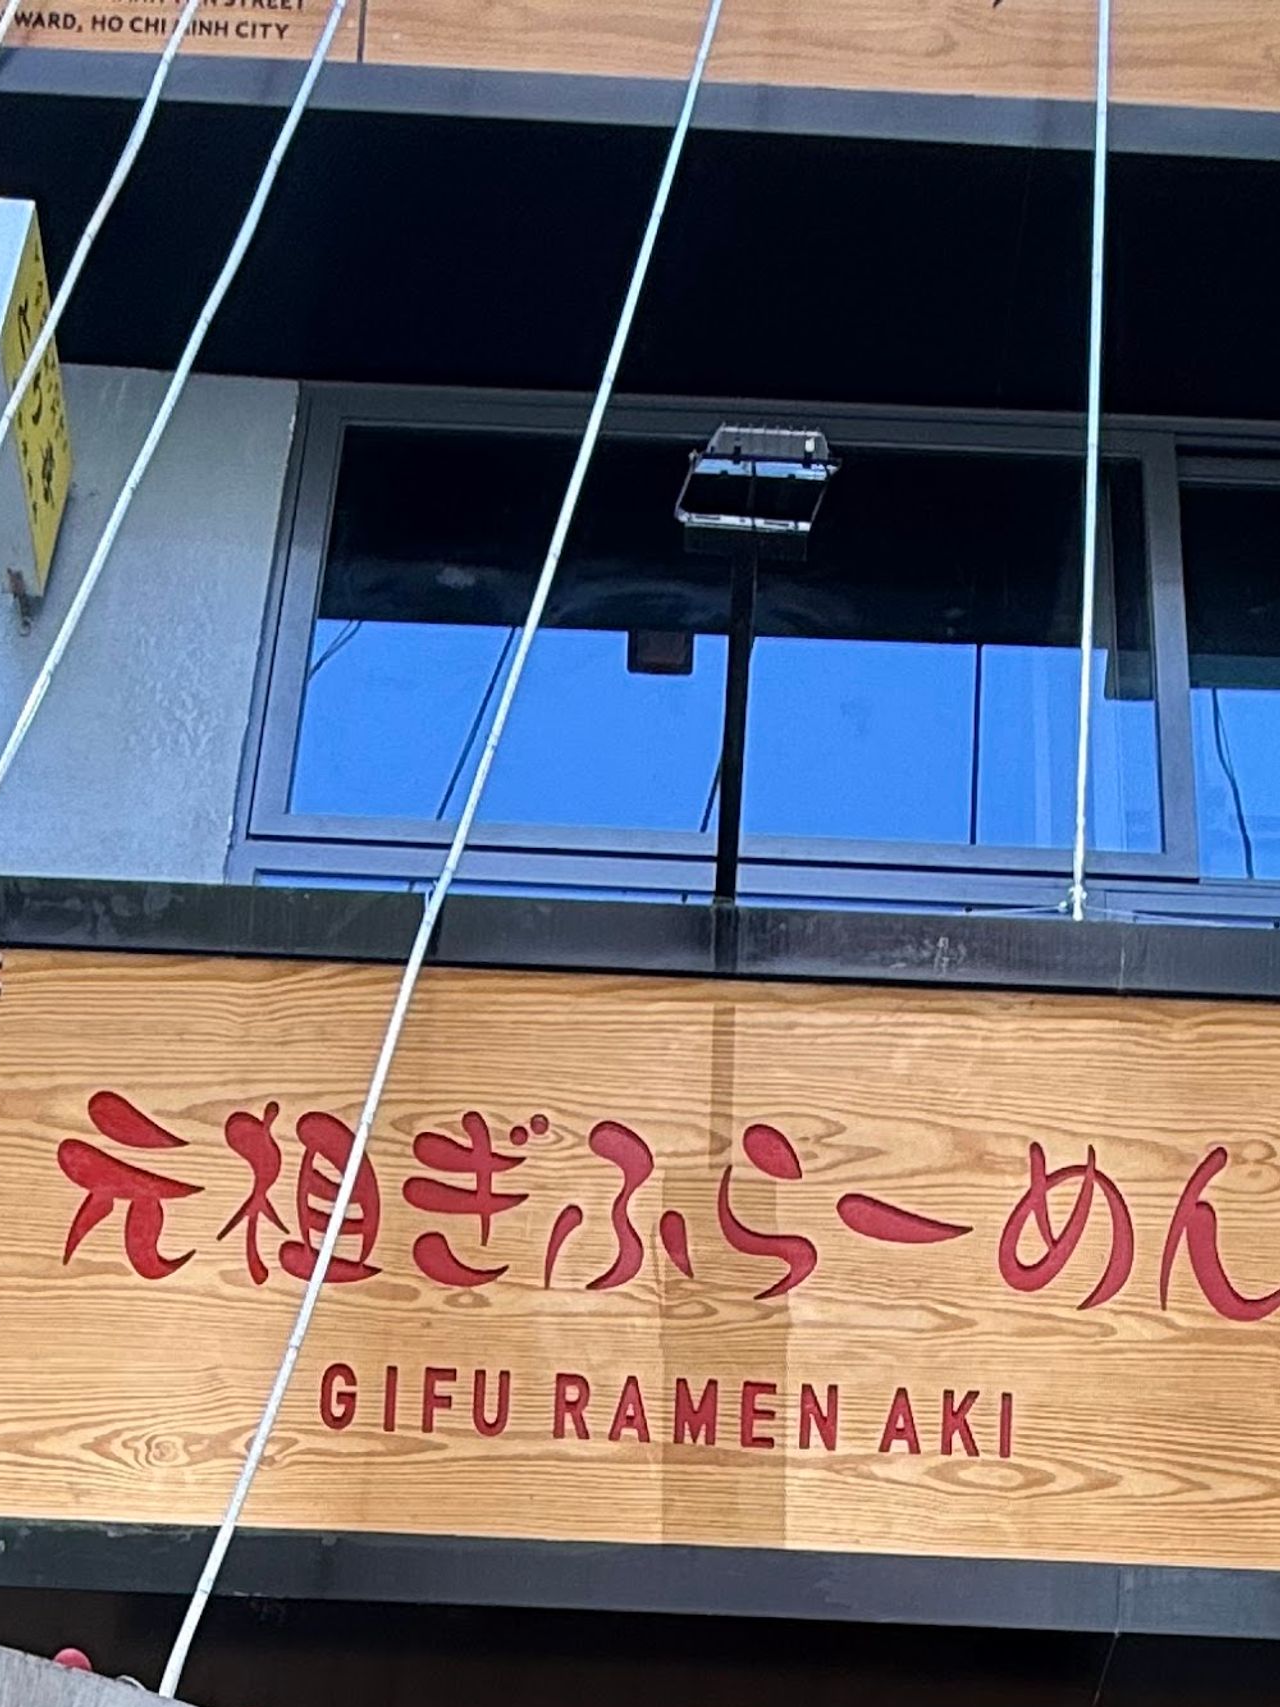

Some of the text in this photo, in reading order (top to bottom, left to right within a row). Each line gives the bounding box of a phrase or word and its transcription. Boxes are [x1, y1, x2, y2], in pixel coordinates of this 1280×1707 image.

[91, 15, 123, 32] HO
[129, 17, 165, 35] CHI
[235, 21, 289, 39] CITY
[320, 1362, 1013, 1460] GIFU RAMEN AKI
